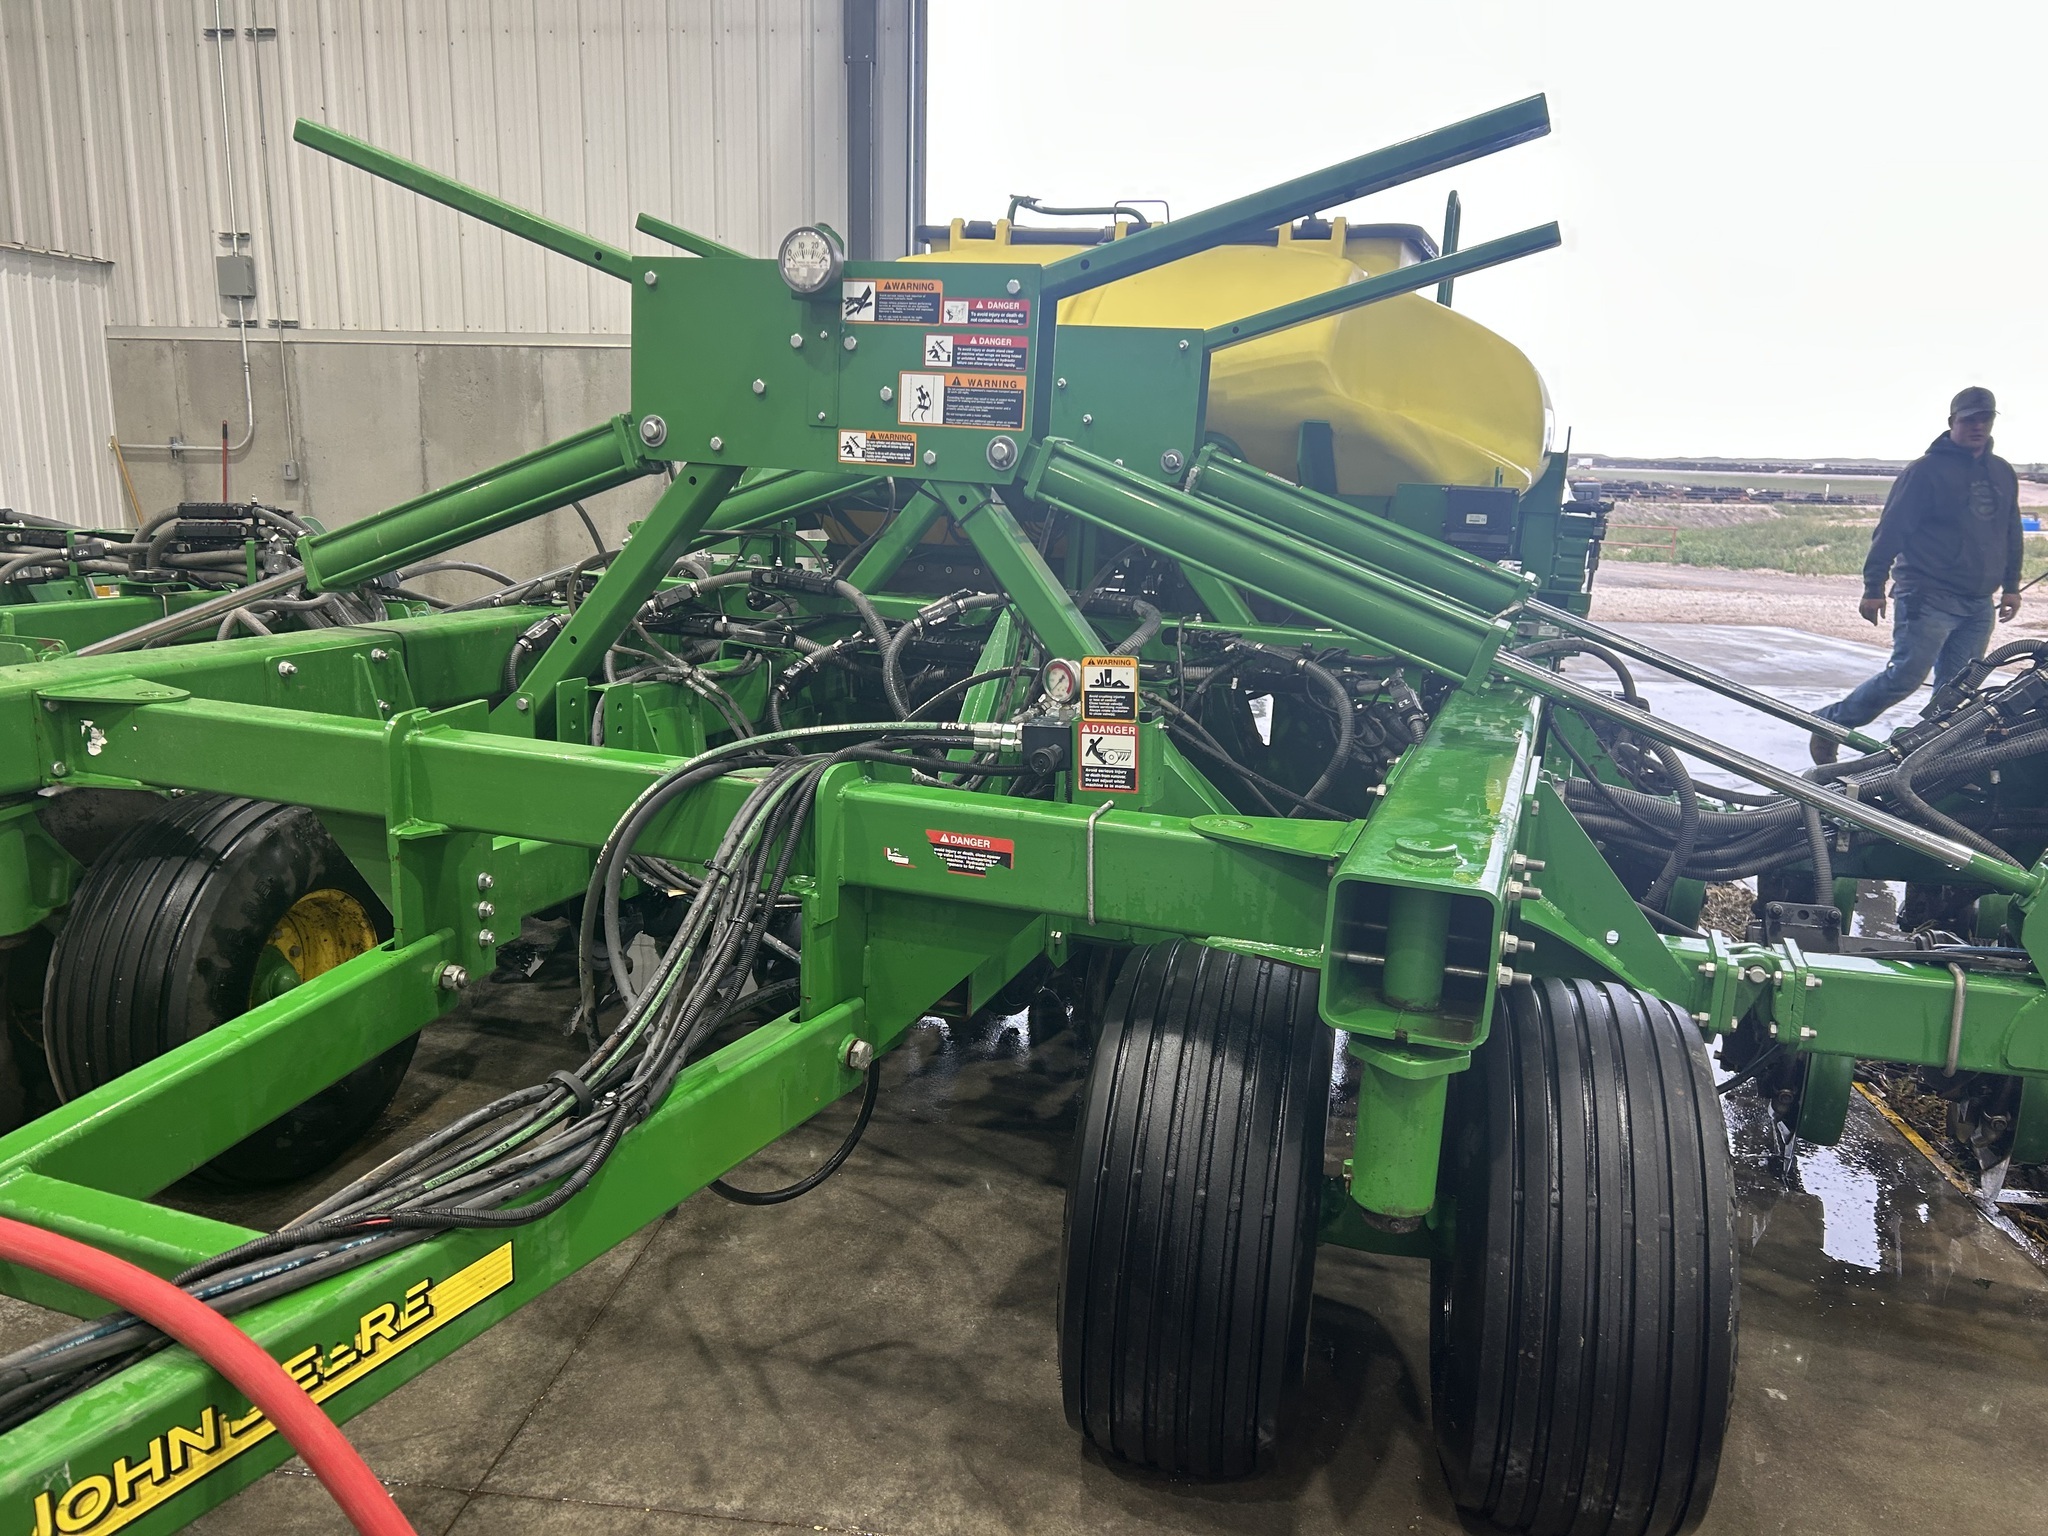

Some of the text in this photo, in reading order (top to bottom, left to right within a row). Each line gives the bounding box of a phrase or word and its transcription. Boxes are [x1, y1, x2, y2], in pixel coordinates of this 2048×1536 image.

[892, 282, 934, 290] WARNING
[988, 302, 1020, 310] DANGER
[979, 337, 1012, 346] DANGER
[968, 379, 1017, 388] WARNING
[1092, 724, 1135, 735] DANGER
[950, 836, 990, 848] DANGER
[33, 1277, 433, 1536] JOHN ERE
